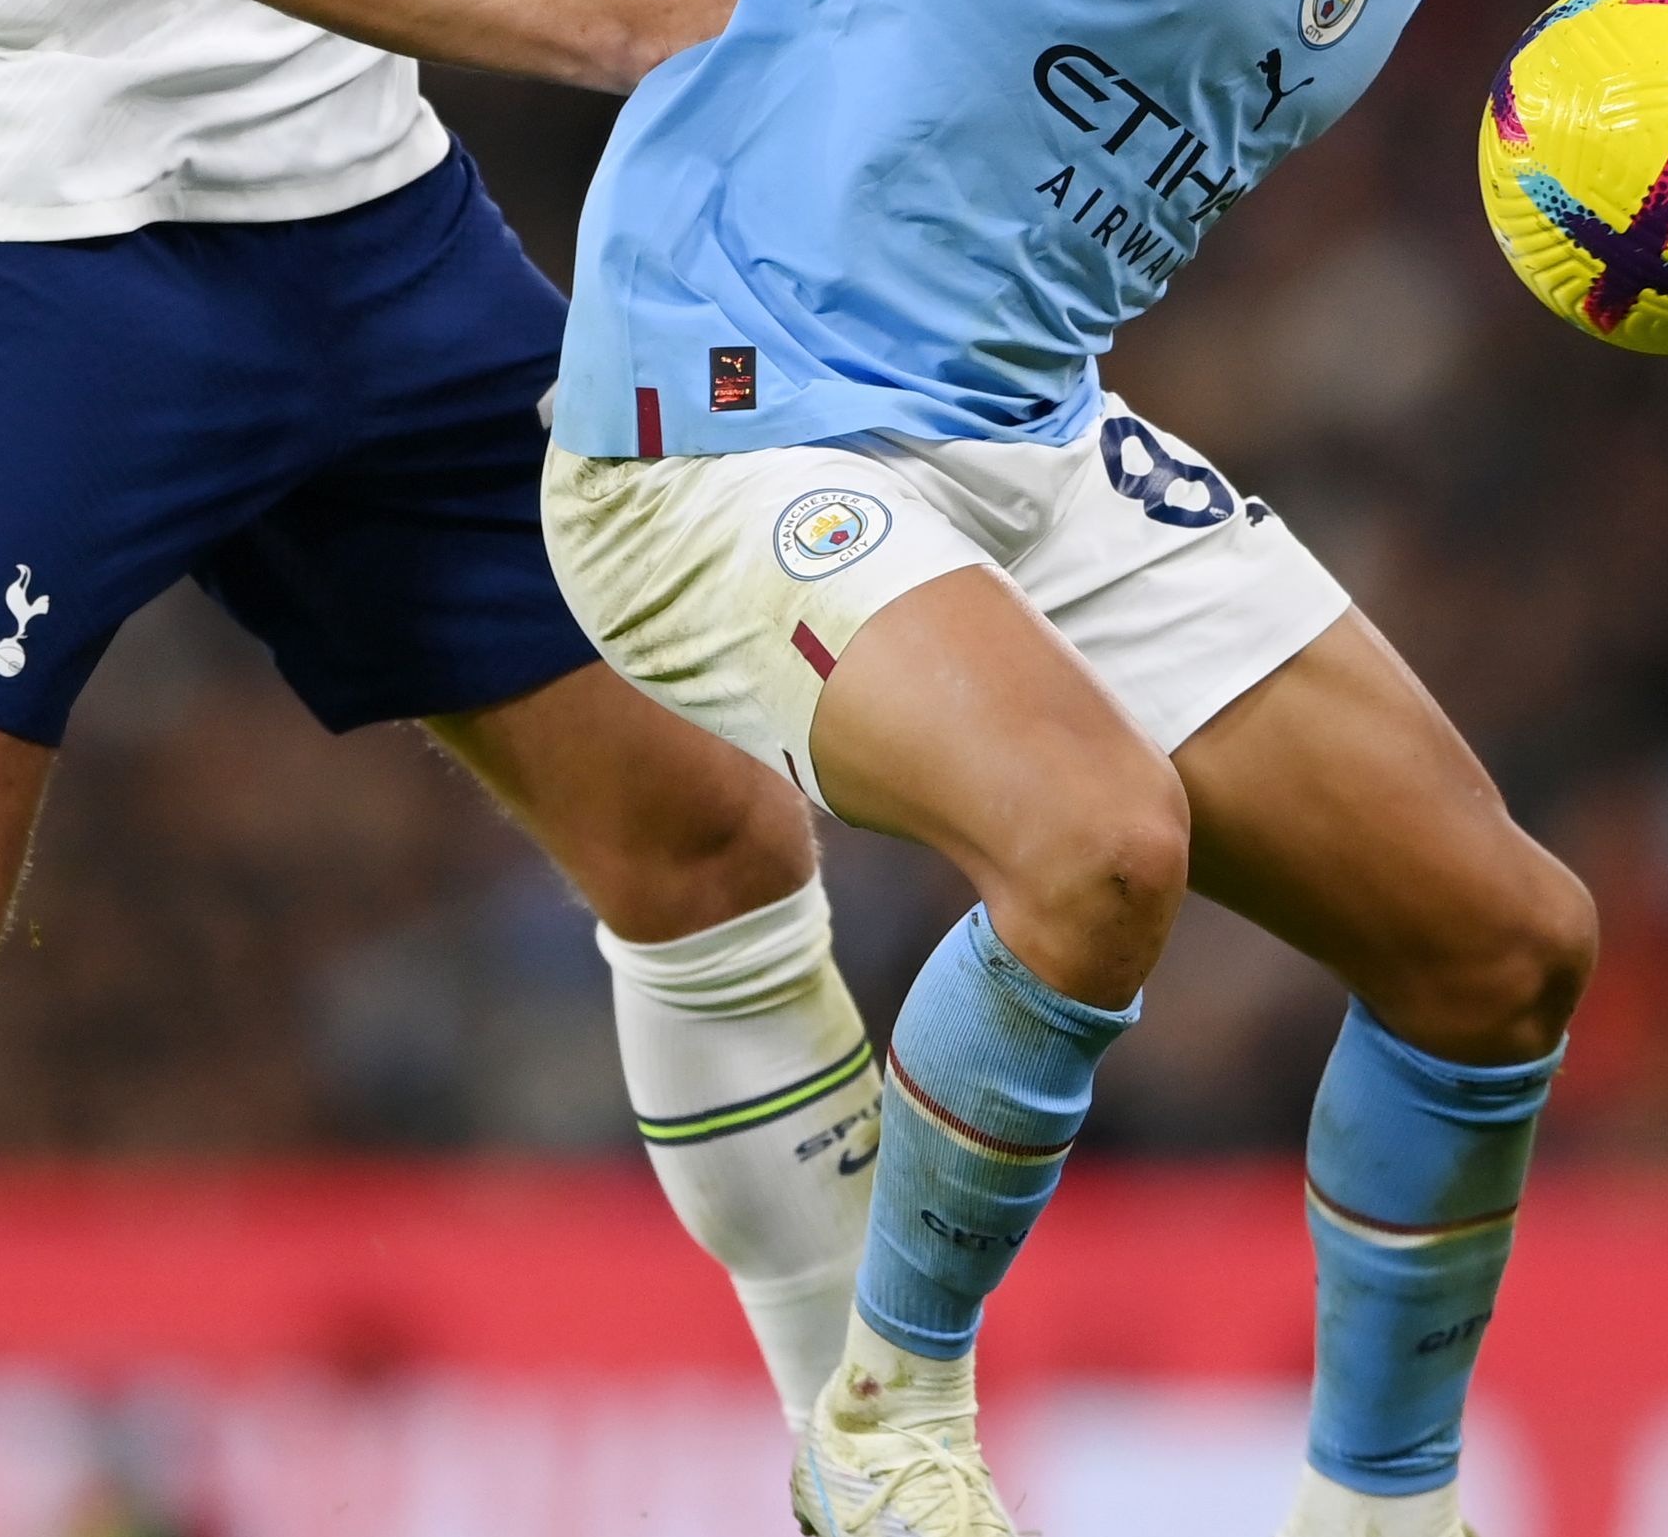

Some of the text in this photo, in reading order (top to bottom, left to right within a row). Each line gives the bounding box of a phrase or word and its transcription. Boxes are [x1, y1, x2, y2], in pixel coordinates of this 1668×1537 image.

[1305, 24, 1324, 43] CITY
[782, 494, 861, 552] MANCHESTER
[839, 539, 869, 562] CITY
